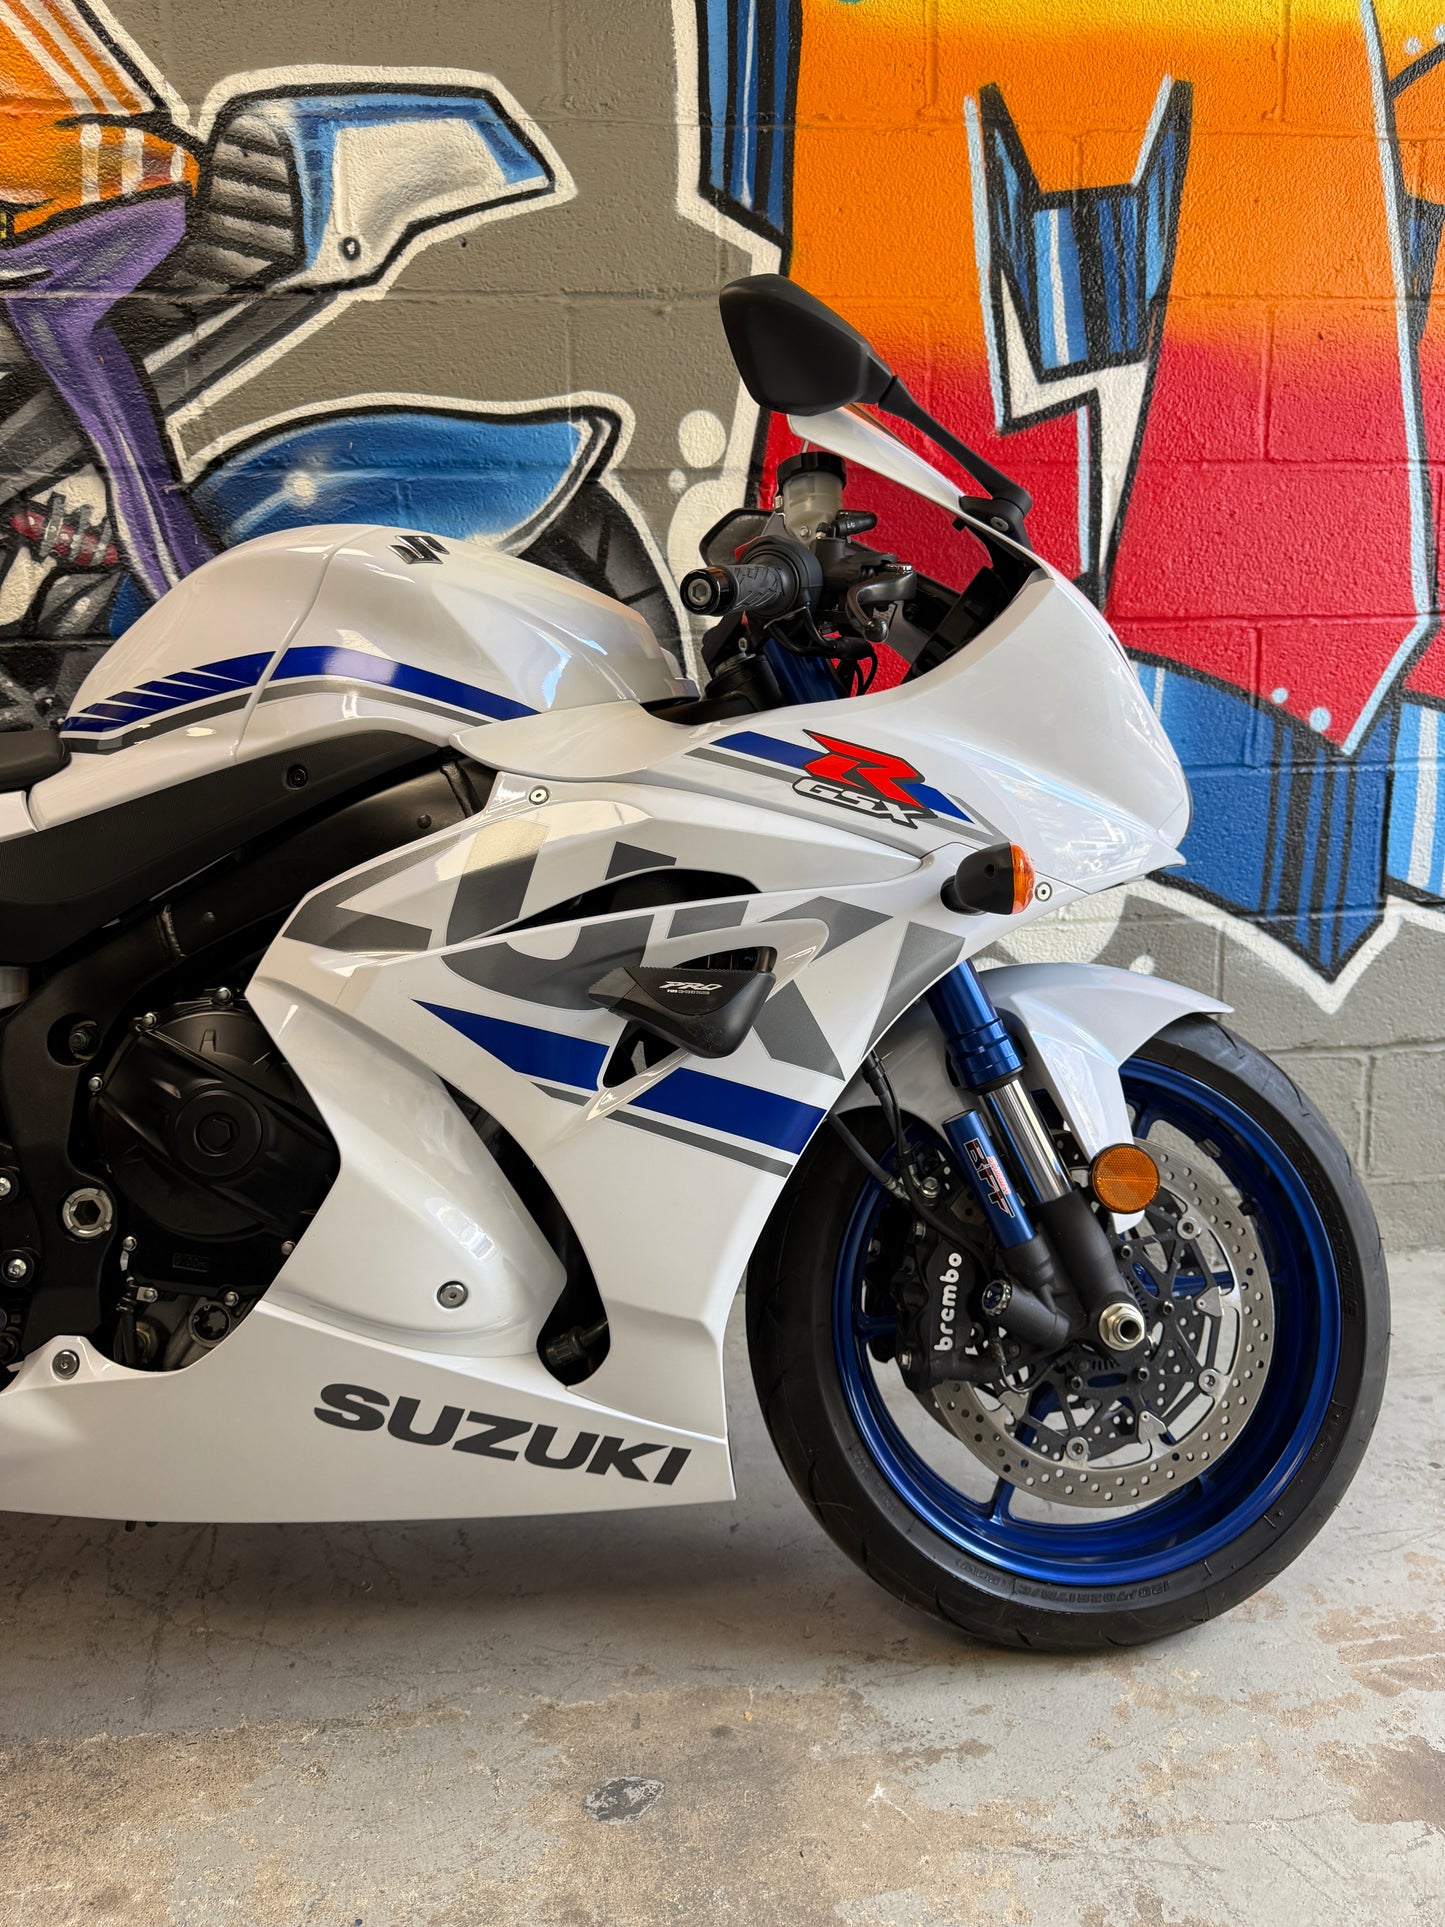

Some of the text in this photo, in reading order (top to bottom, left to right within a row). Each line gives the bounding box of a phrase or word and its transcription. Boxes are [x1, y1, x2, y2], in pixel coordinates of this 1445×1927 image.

[792, 776, 922, 829] GSX
[964, 1138, 1016, 1218] BPF
[934, 1252, 963, 1351] brembo
[314, 1383, 692, 1486] SUZUKI
